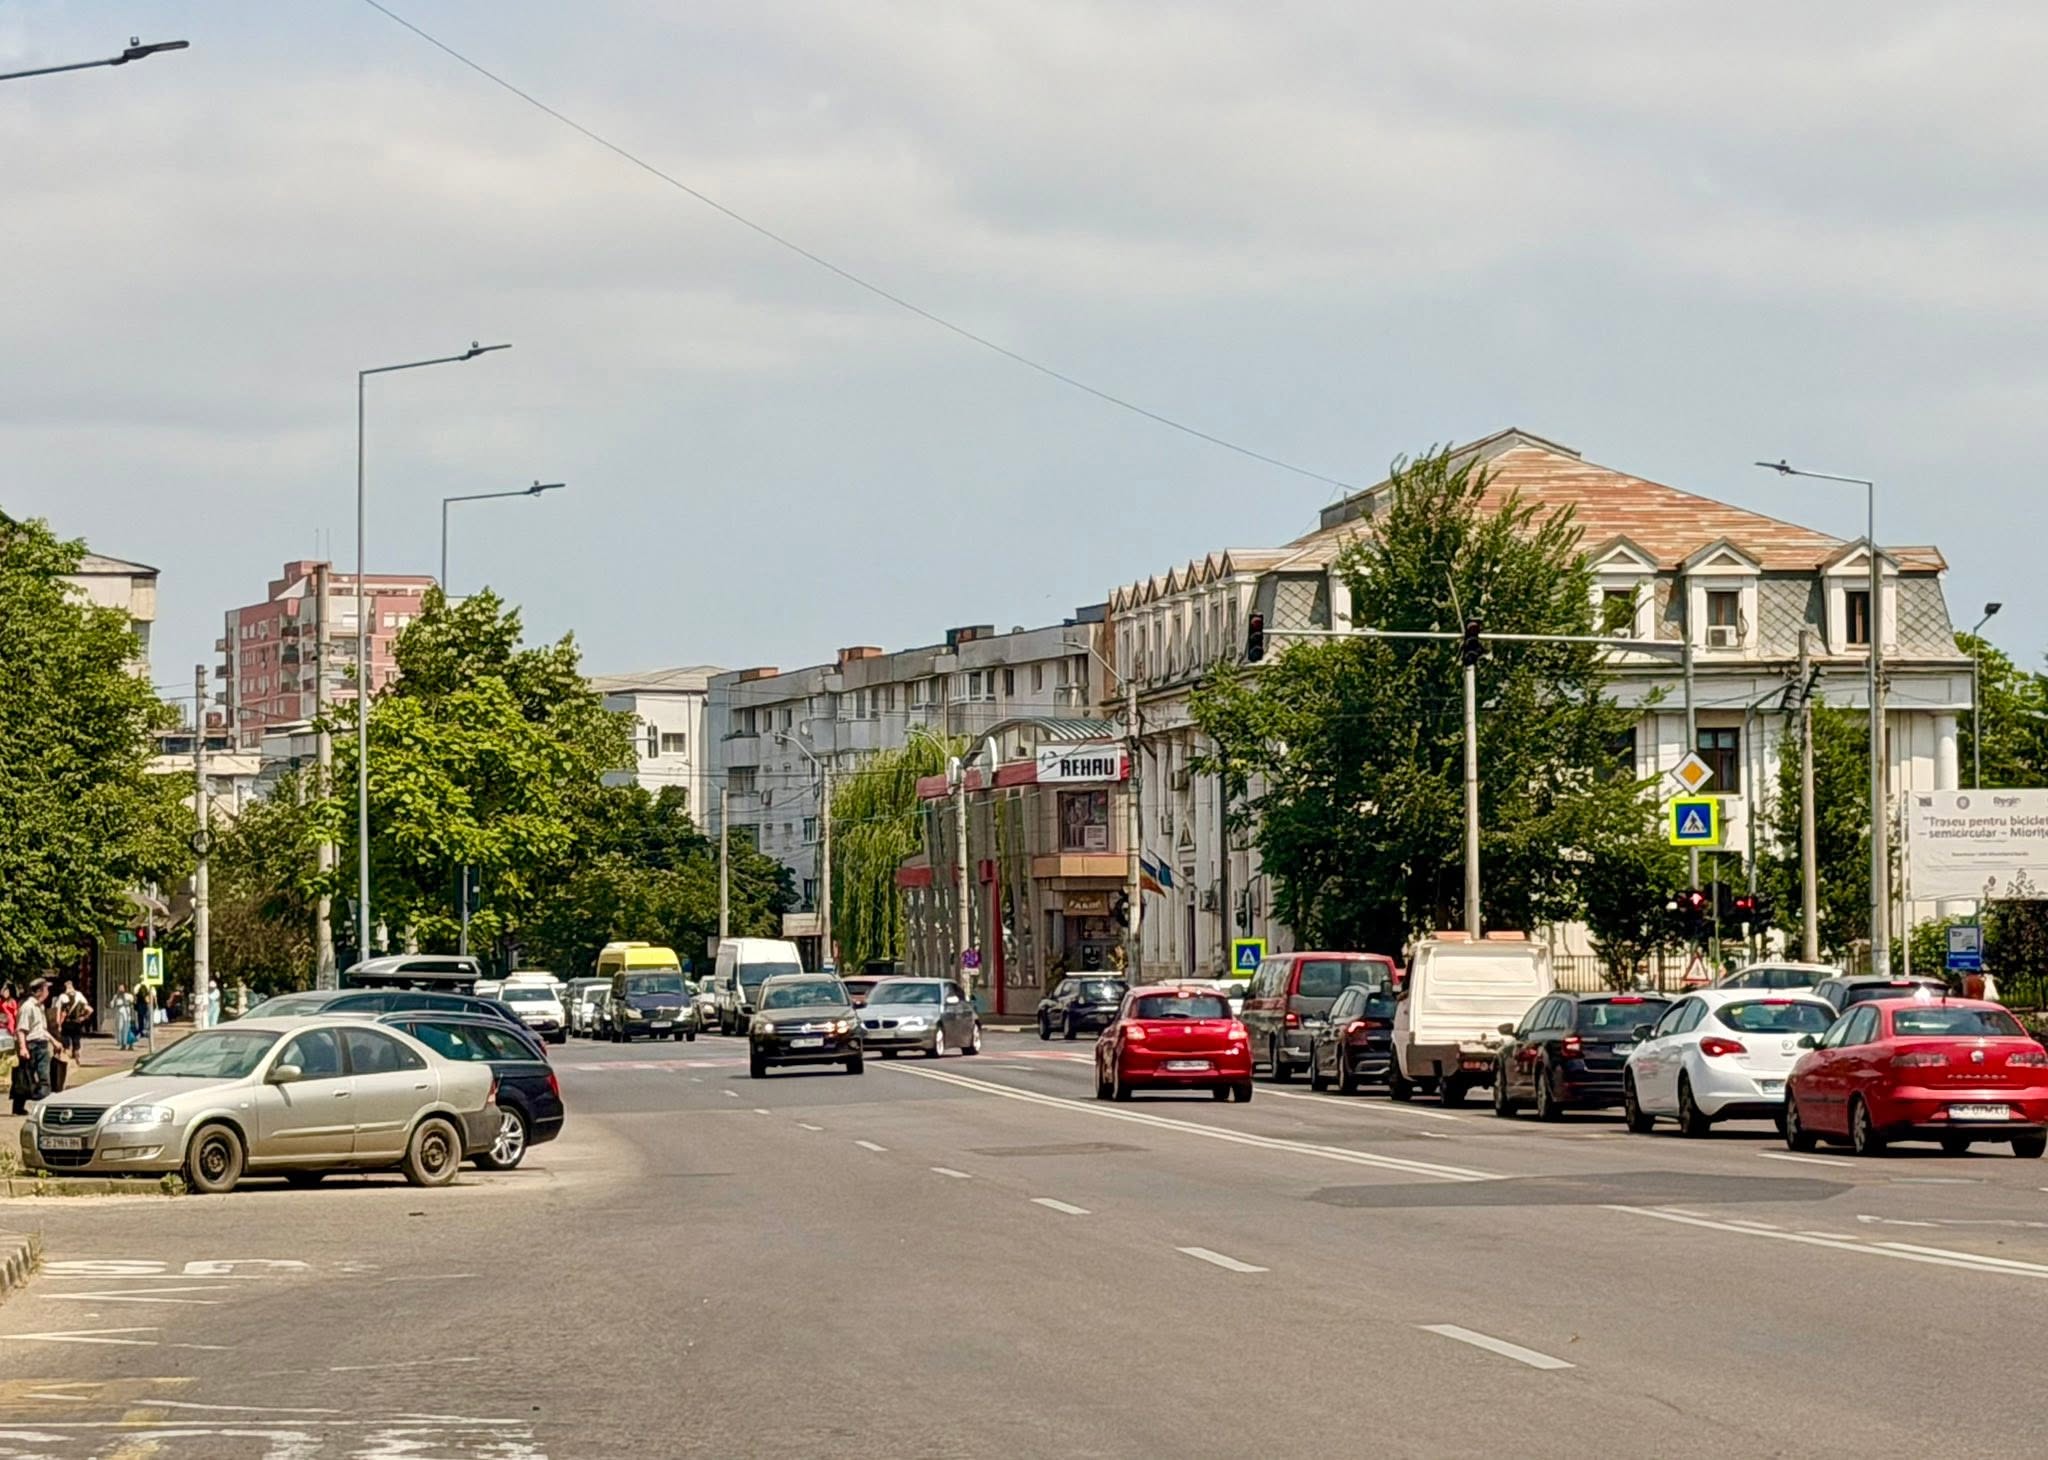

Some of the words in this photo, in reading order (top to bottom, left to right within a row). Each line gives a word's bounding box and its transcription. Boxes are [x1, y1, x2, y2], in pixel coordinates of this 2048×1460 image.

[1060, 758, 1115, 777] REHAU
[1968, 817, 2007, 829] pentru
[1929, 828, 1997, 838] semicircular
